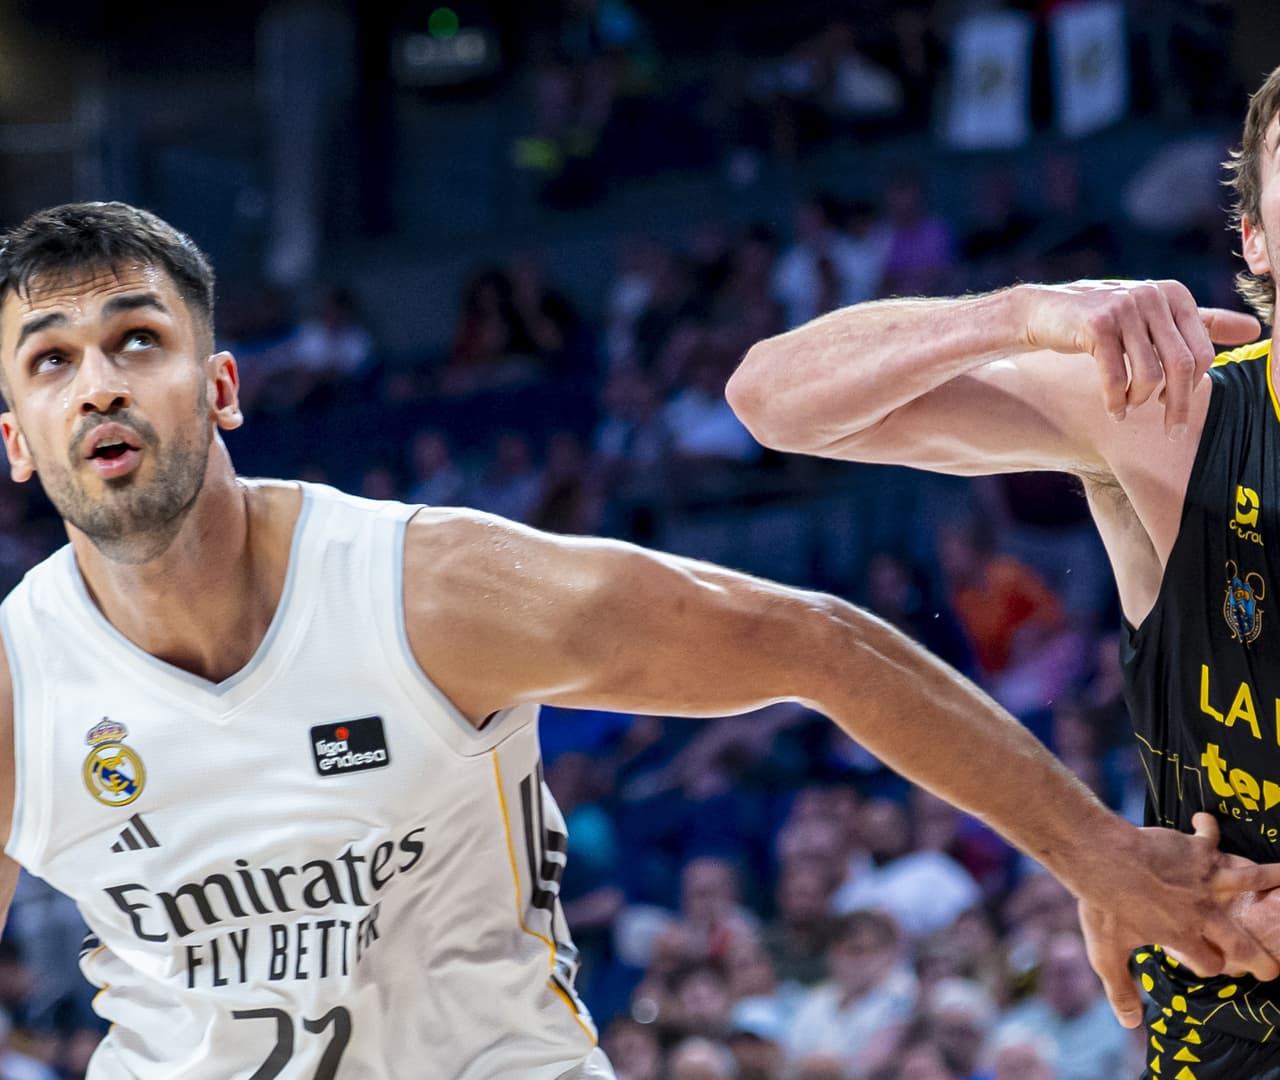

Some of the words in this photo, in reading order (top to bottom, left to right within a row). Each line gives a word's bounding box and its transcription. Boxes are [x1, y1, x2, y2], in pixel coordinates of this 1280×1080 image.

[1200, 663, 1262, 739] LA
[315, 740, 348, 757] liga
[319, 751, 387, 770] endesa
[104, 827, 426, 942] Emirates
[185, 927, 250, 989] FLY
[269, 900, 383, 981] BETTER
